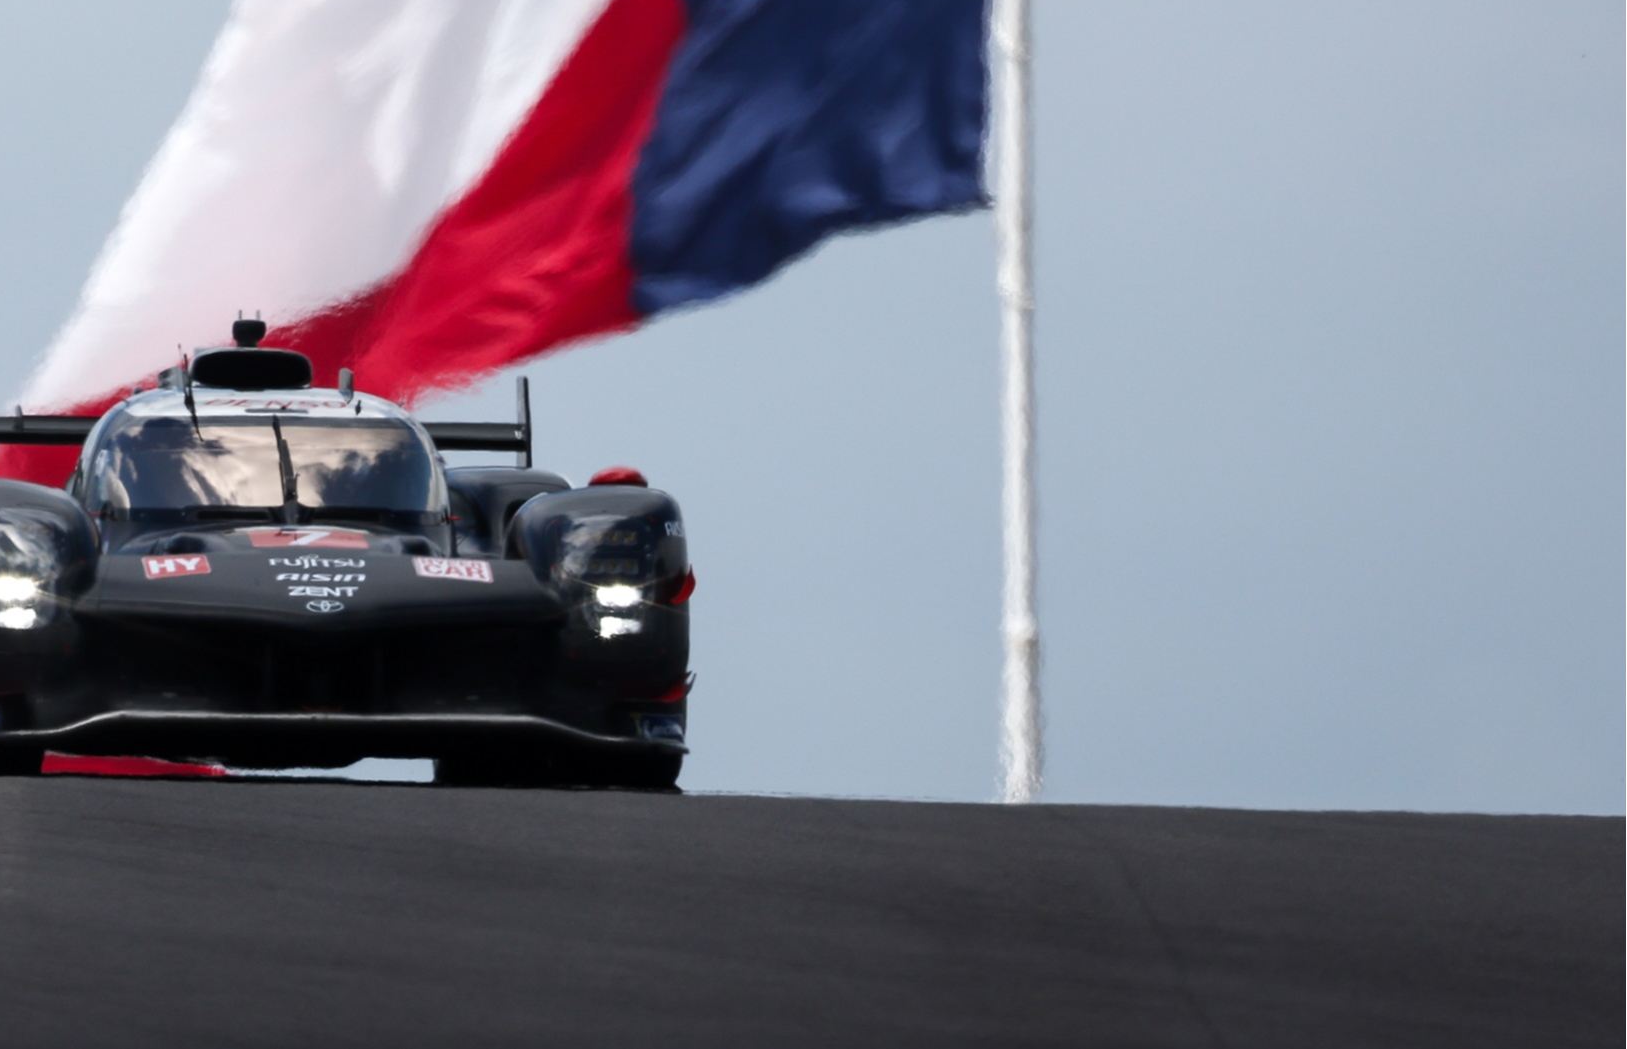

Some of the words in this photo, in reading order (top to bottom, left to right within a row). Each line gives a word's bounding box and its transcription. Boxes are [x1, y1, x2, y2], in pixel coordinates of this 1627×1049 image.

[204, 398, 348, 409] DENSO
[278, 529, 331, 547] 7
[148, 556, 202, 574] HY
[268, 554, 366, 569] FUJITSU
[276, 573, 367, 583] AISIN
[423, 564, 486, 580] CAR
[288, 585, 359, 597] ZENT
